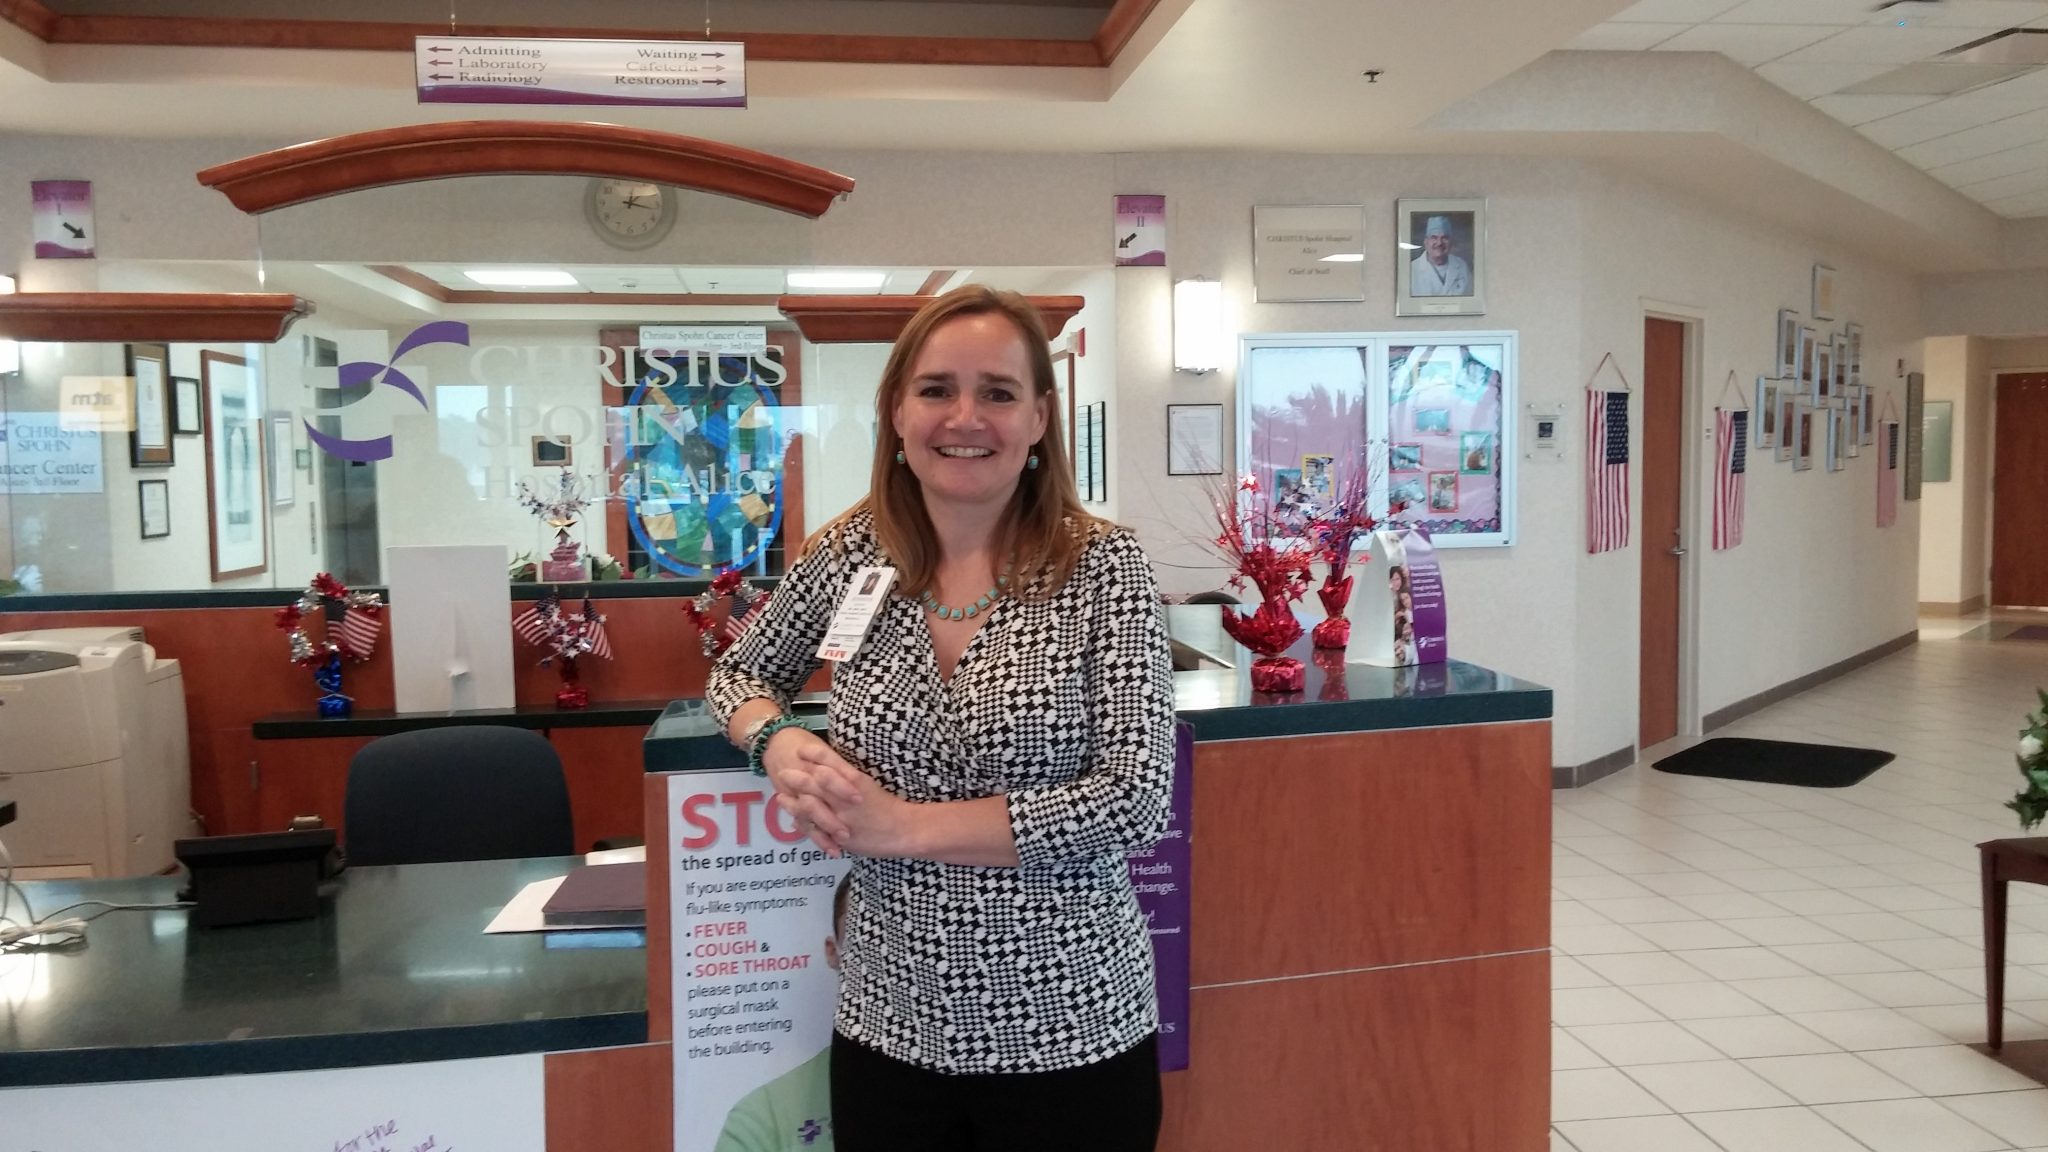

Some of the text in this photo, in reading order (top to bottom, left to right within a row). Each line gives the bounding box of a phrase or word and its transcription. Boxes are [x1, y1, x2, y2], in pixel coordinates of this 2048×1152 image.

[458, 45, 542, 58] Admitting
[637, 49, 698, 61] Waiting
[459, 58, 547, 71] Laboratory
[626, 62, 698, 72] Cafeteria
[459, 72, 542, 85] Radiology
[615, 75, 699, 86] Restrooms
[641, 329, 764, 342] Christus Spohn Cancer Center
[470, 344, 788, 388] CHRISTUS
[15, 424, 98, 439] CHRISTUS
[475, 403, 688, 447] SPOHN
[17, 440, 71, 452] SPOHN
[42, 460, 97, 475] Center
[678, 462, 777, 498] Alice
[681, 790, 809, 849] STO
[682, 848, 853, 871] the spread of gers
[1131, 862, 1172, 876] Health
[686, 874, 836, 898] If you are experiencing
[1134, 881, 1178, 896] change.
[686, 896, 808, 916] flu-like symptoms:
[694, 921, 748, 938] FEVER
[694, 940, 770, 958] COUGH &
[695, 954, 811, 978] SORE THROAT
[688, 980, 790, 1001] please put on a
[688, 998, 779, 1020] surgical mask
[688, 1019, 792, 1039] before entering
[688, 1040, 774, 1059] the building.
